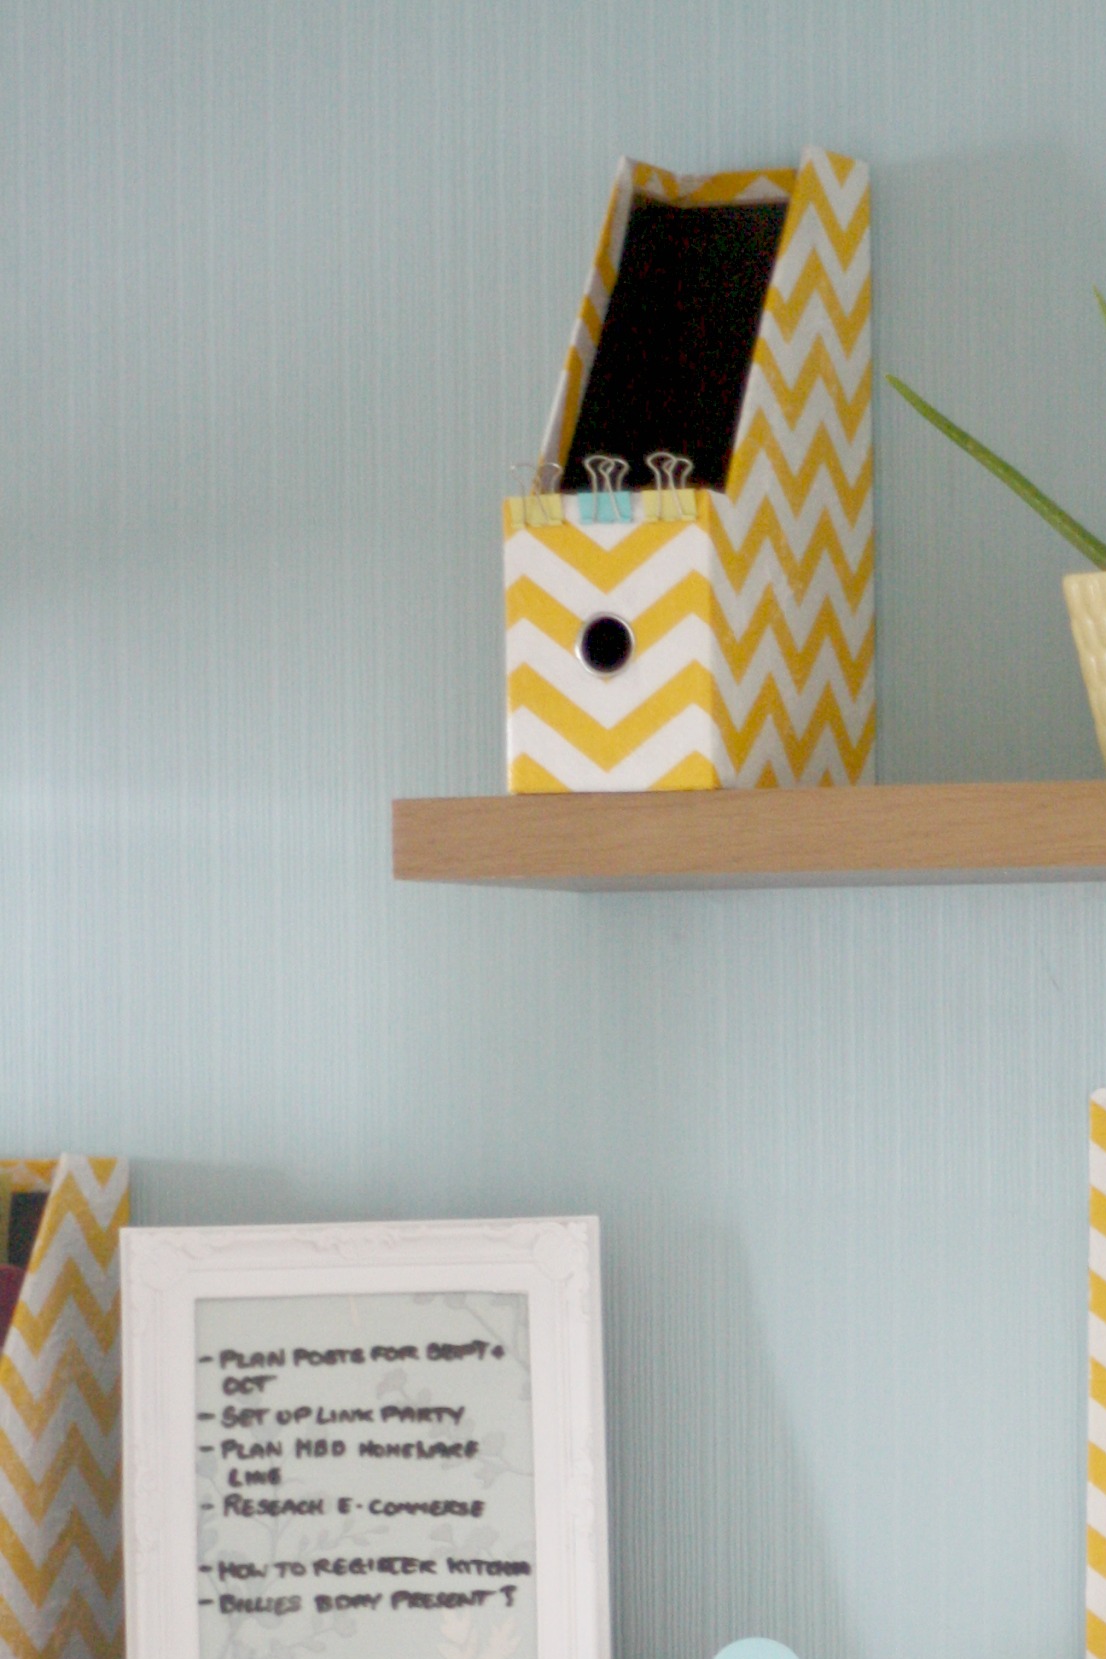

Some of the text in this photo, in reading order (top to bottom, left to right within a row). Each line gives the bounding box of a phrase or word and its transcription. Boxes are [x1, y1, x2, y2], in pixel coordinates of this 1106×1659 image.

[220, 1348, 285, 1369] PLAN
[370, 1345, 420, 1362] FOR
[222, 1374, 278, 1395] OCT
[220, 1405, 271, 1429] SET
[275, 1406, 313, 1425] UP
[381, 1405, 466, 1426] PARTY
[220, 1438, 283, 1460] PLAN
[217, 1560, 268, 1581] HOW
[275, 1560, 306, 1578] TO
